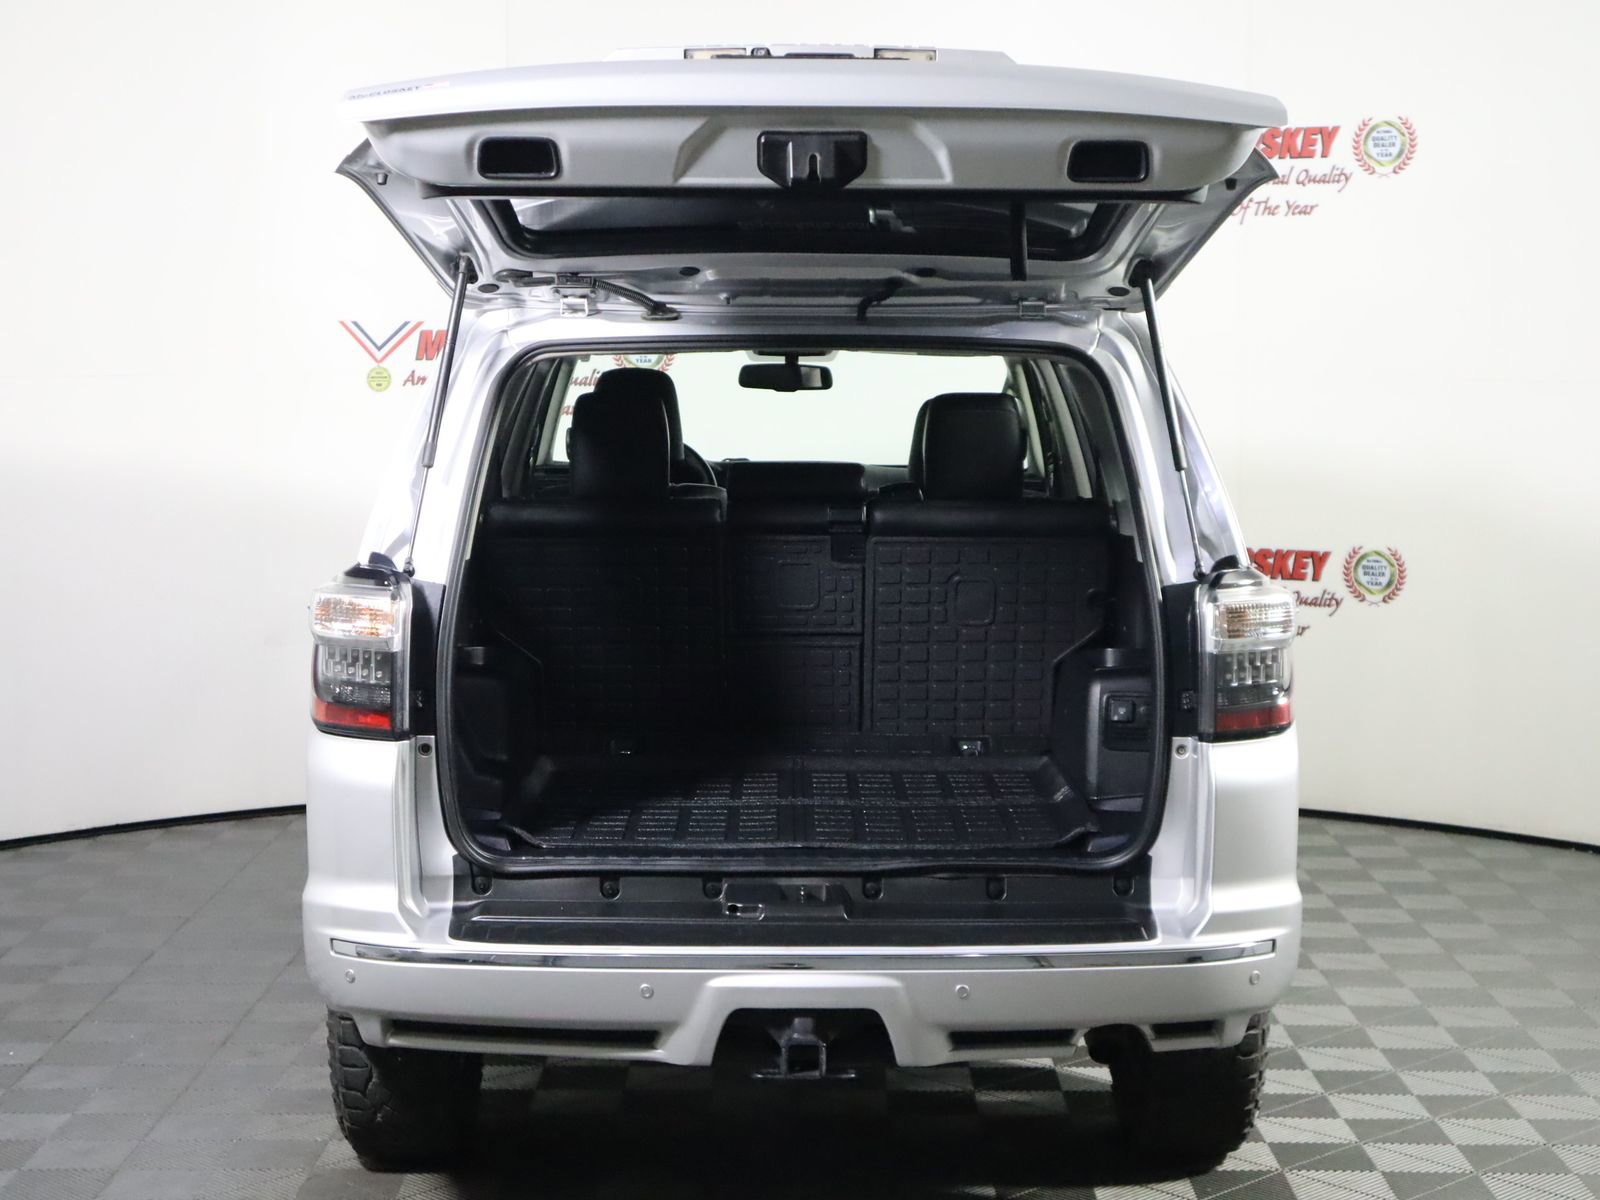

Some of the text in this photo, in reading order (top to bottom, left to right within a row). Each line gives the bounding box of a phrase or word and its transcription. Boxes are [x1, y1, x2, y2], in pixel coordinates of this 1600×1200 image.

[1255, 126, 1340, 160] SKEY
[1296, 165, 1353, 193] Quality
[1254, 196, 1280, 217] The
[1283, 199, 1319, 217] Year
[415, 329, 448, 361] M
